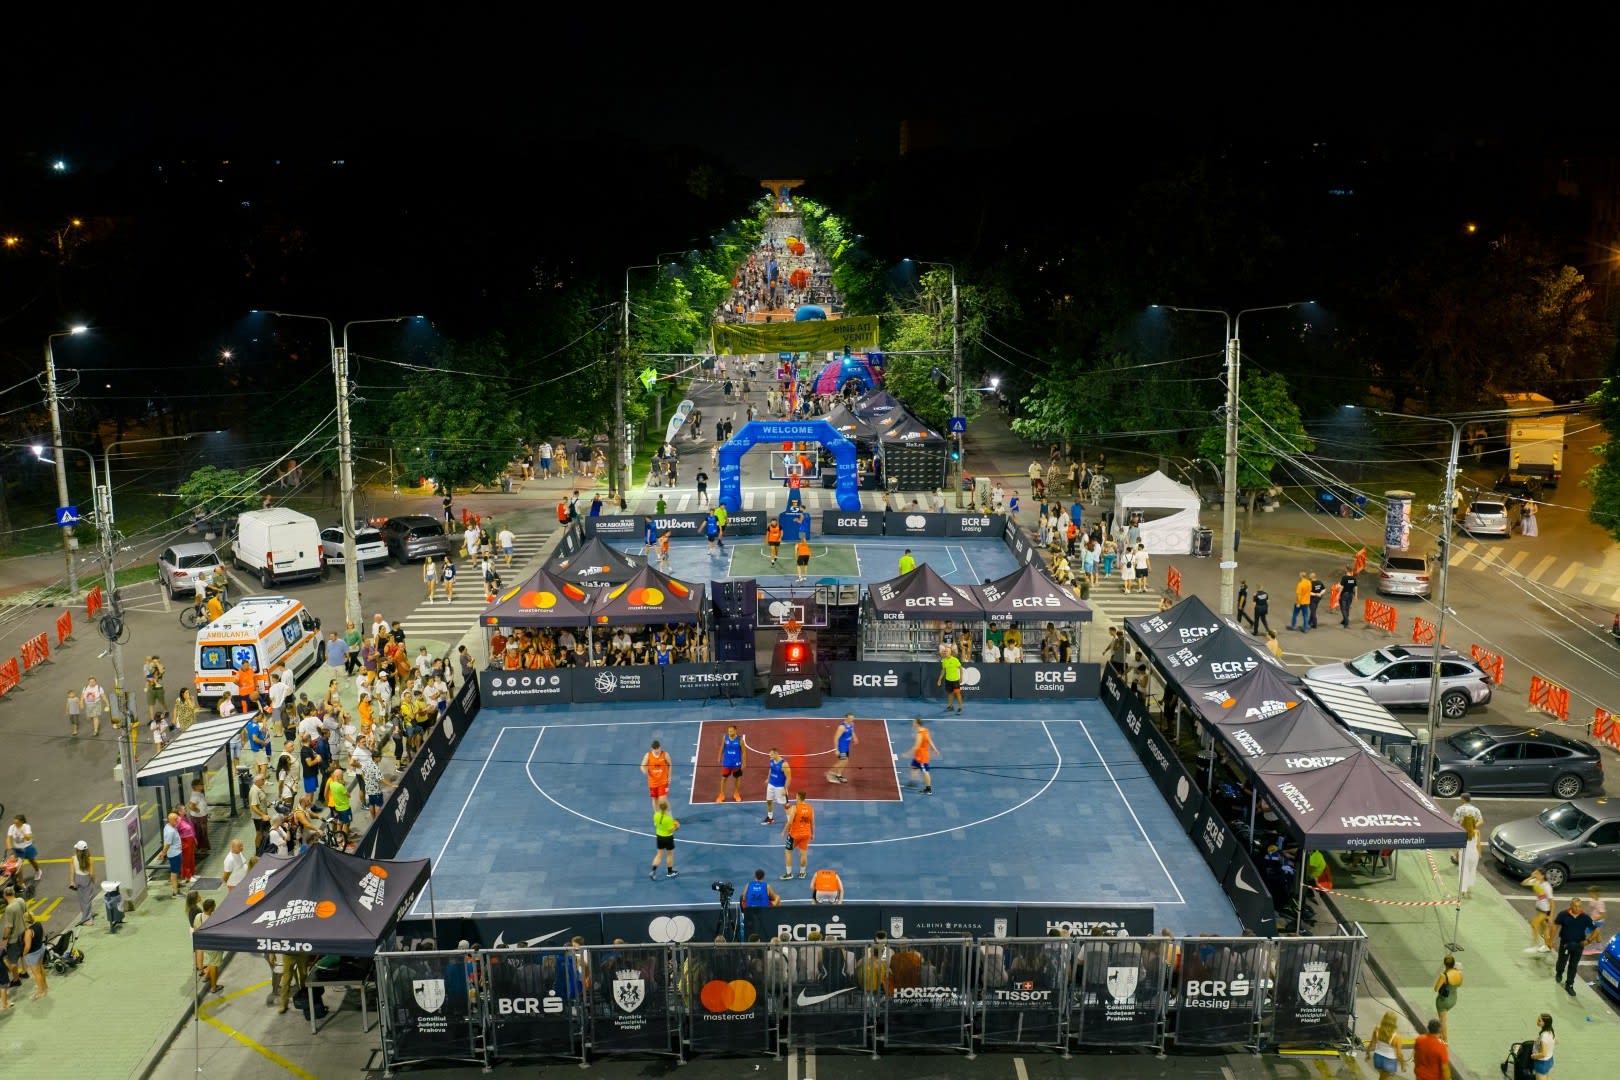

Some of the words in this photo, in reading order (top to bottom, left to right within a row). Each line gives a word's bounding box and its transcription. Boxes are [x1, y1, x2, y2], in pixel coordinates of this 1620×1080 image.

[763, 426, 814, 434] WELCOME
[655, 519, 696, 530] Wilson
[837, 518, 857, 527] BCR
[961, 517, 980, 526] BCR
[905, 597, 936, 608] BCR
[1012, 596, 1043, 608] BCR
[1179, 627, 1208, 638] BCR
[1210, 661, 1243, 673] BCR
[696, 672, 739, 682] TISSOT
[852, 674, 881, 688] BCR
[1035, 671, 1062, 683] BCR
[1035, 683, 1065, 692] Leasing
[1341, 814, 1422, 828] HORIZON
[1205, 816, 1220, 845] BCR
[1347, 837, 1425, 846] enjoy.evolve.entertain
[286, 899, 318, 908] SPORT
[251, 906, 316, 924] ARENA
[265, 912, 316, 929] STREETBALL
[1046, 920, 1125, 936] HORIZON
[256, 938, 313, 952] 3la3.ro
[893, 986, 957, 999] HORIZON
[1186, 980, 1227, 997] BCR
[995, 990, 1052, 1001] TISSOT
[498, 997, 540, 1015] BCR
[1185, 998, 1230, 1010] Leasing
[703, 1012, 755, 1021] mastercard
